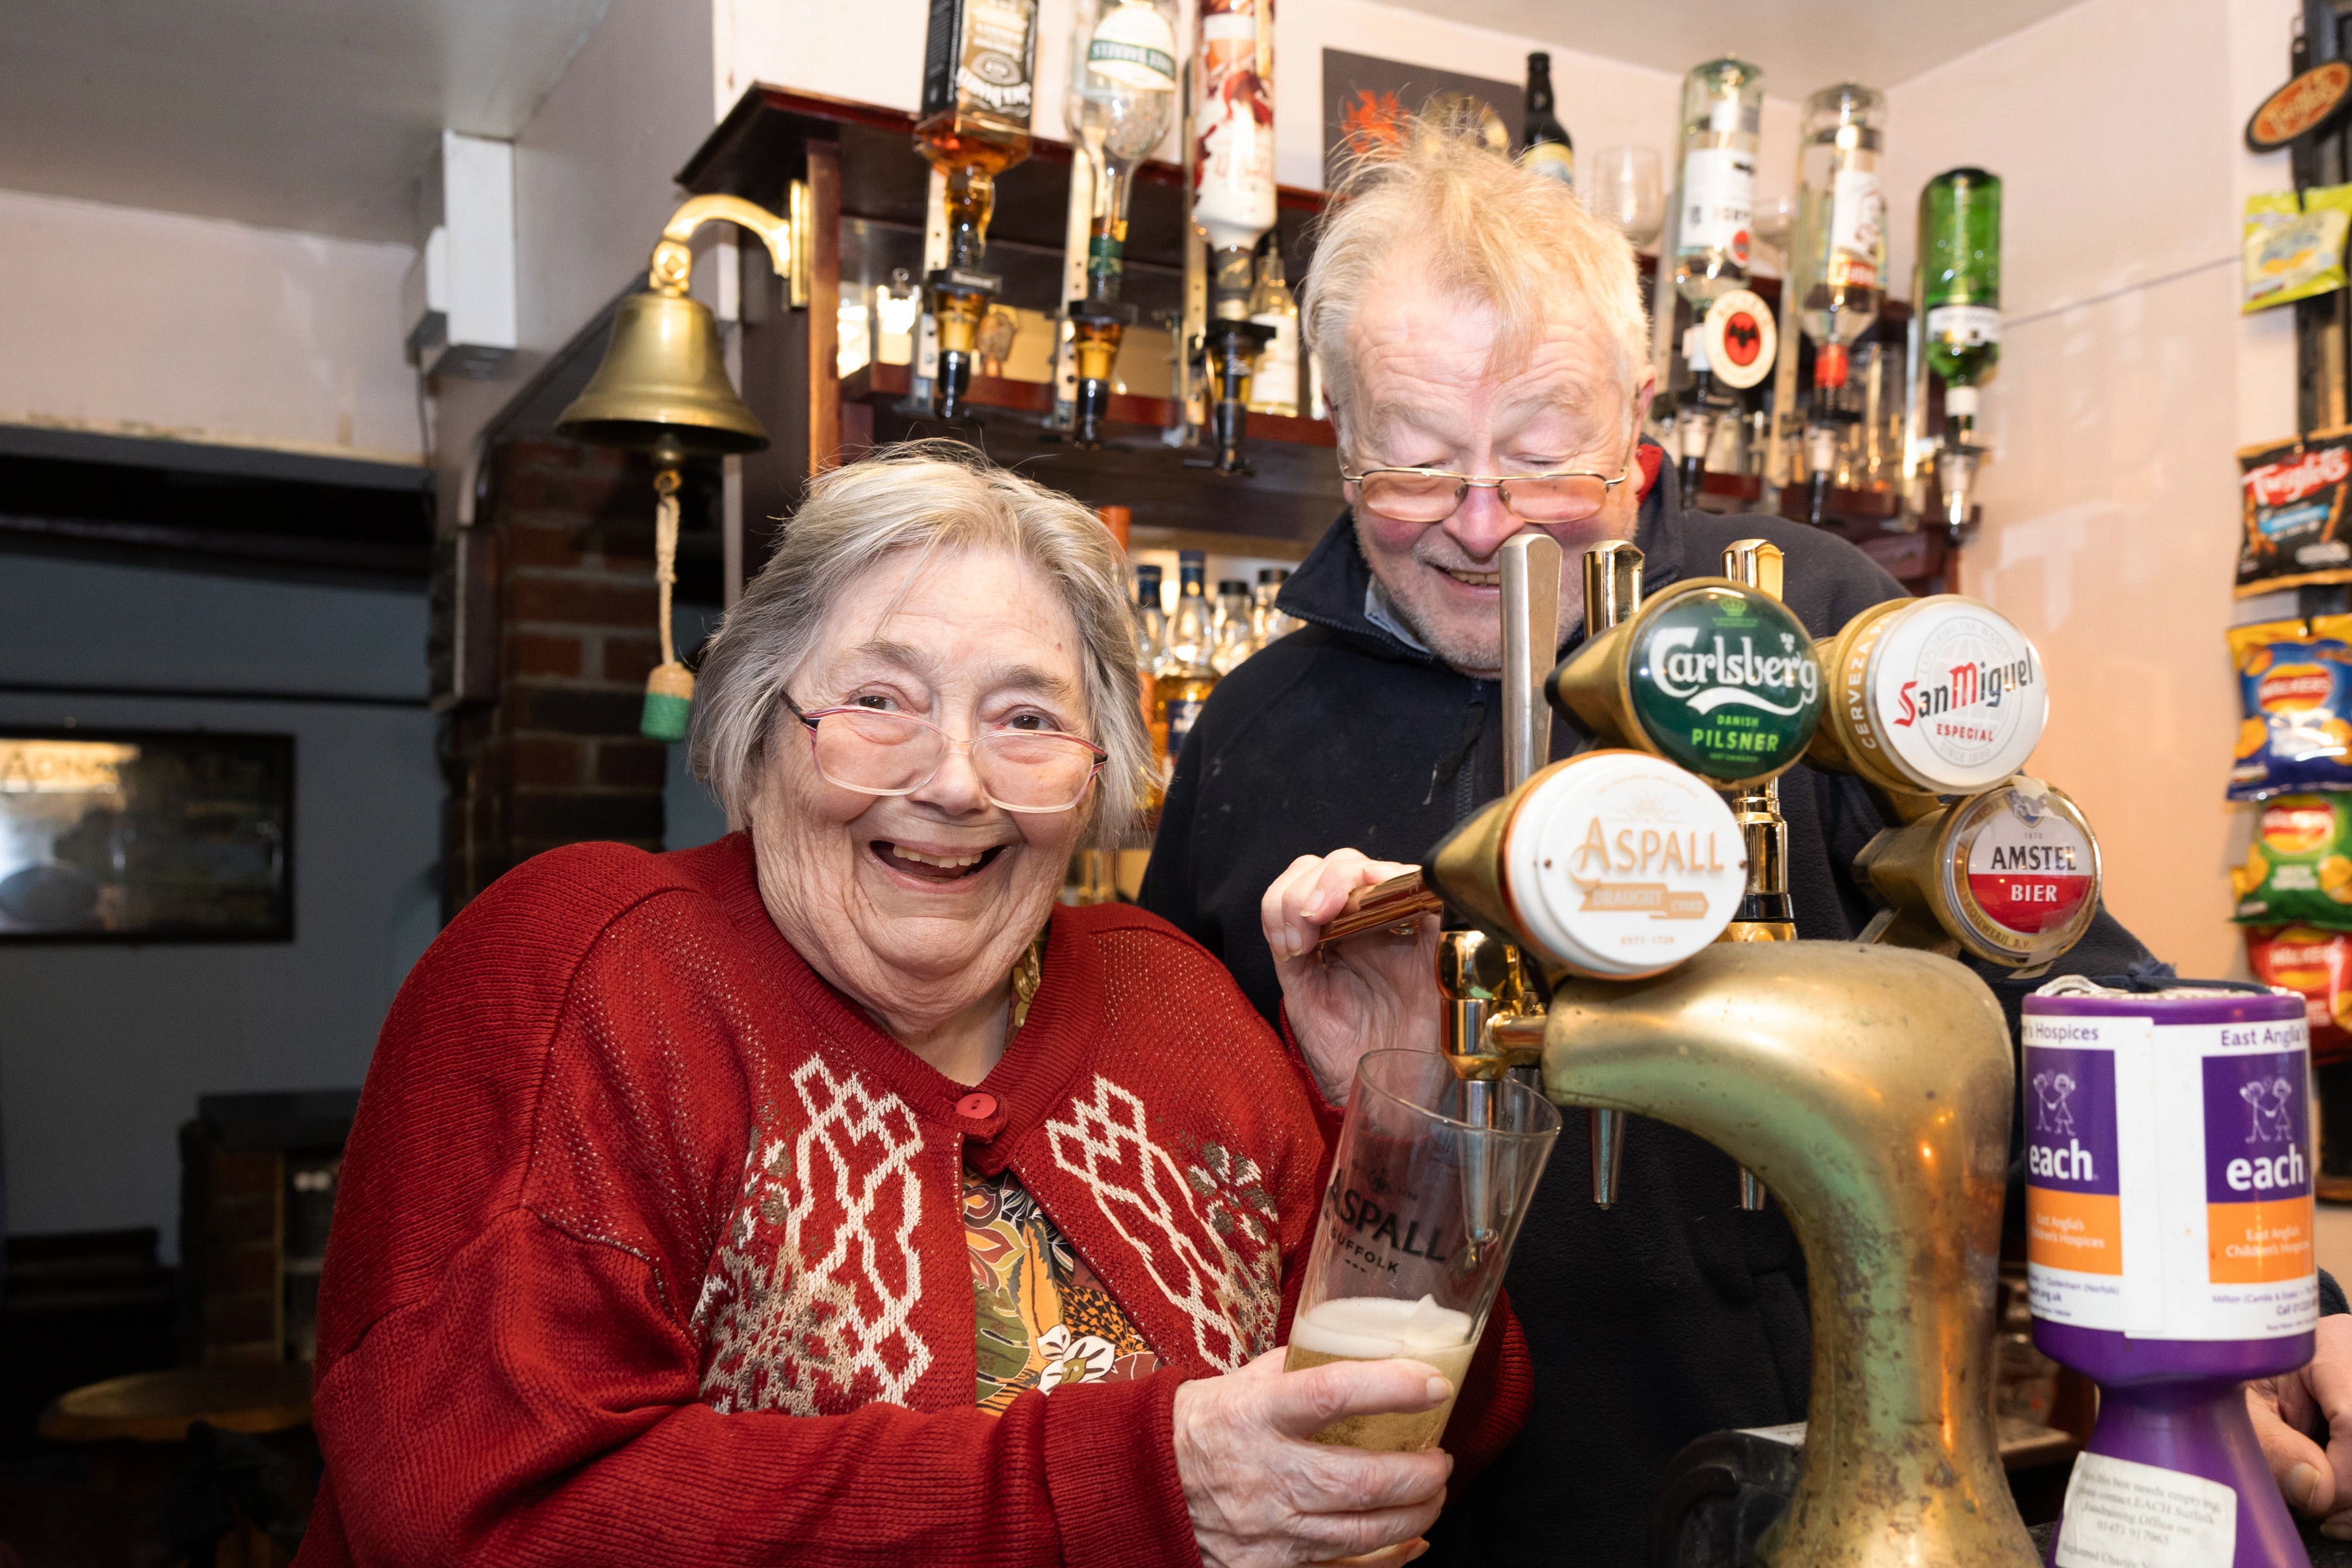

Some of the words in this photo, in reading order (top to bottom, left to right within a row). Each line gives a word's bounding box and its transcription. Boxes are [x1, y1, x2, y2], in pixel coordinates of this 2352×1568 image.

[1648, 627, 1818, 705] Carlsberg
[1848, 641, 1877, 749] CERVEZA
[1716, 714, 1759, 727] DANISH
[1936, 723, 1994, 742] ESPECIAL
[1691, 728, 1779, 751] PILSNER
[1569, 815, 1724, 877] ASPALL
[1991, 845, 2077, 871] AMSTEL
[2011, 884, 2057, 902] BIER
[2035, 1023, 2099, 1043] Hospices
[2221, 1029, 2257, 1045] East
[2029, 1137, 2094, 1181] each
[2226, 1143, 2304, 1191] each
[1331, 1226, 1400, 1273] SUFFOLK
